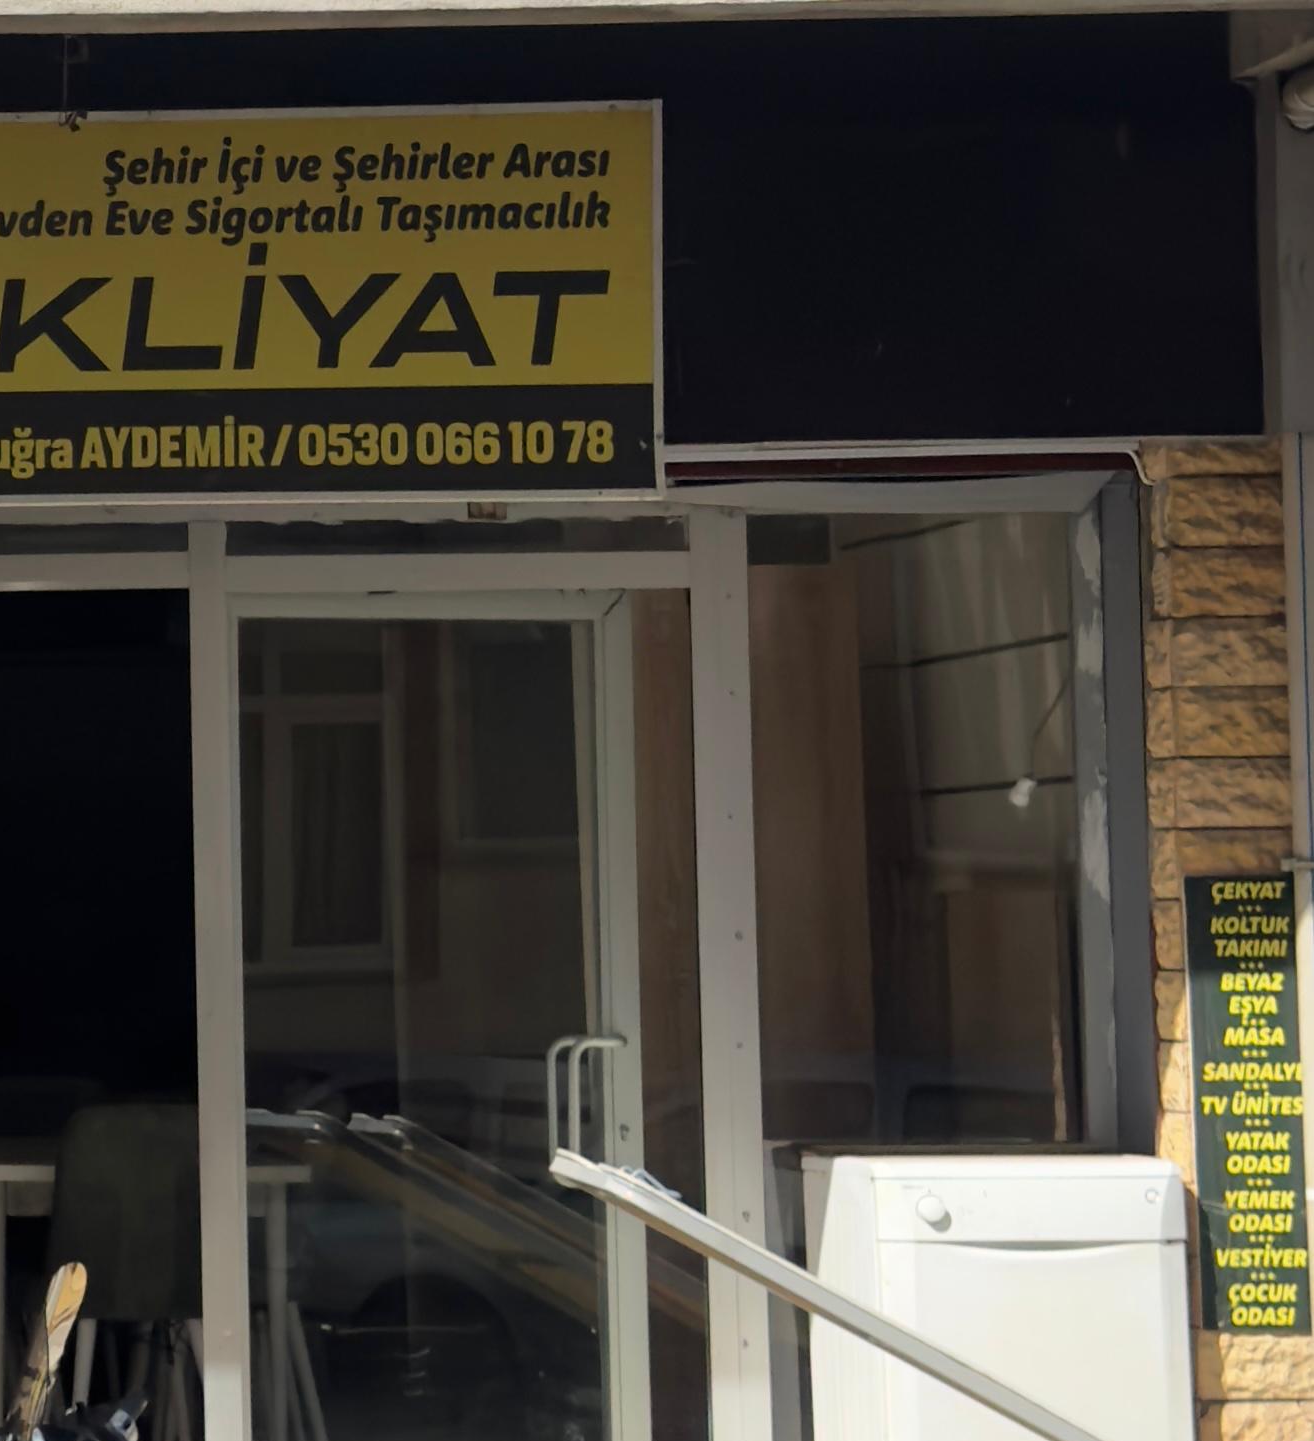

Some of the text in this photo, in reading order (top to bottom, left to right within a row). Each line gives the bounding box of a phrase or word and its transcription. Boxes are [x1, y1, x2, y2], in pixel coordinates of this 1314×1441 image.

[104, 137, 609, 196] Şehir İçi ve Şehirler Arası
[105, 201, 172, 235] Eve
[186, 195, 362, 246] Sigortalı
[378, 192, 609, 241] Taşımacılık
[80, 415, 265, 470] AYDEMİR
[298, 422, 408, 467] 0530
[416, 421, 500, 466] 066
[509, 421, 553, 465] 10
[561, 419, 614, 464] 78
[1211, 882, 1285, 905] ÇEKYAT
[1210, 916, 1290, 934] KOLTUK
[1214, 939, 1287, 958] TAKIMI
[1220, 973, 1285, 992] BEYAZ
[1229, 996, 1278, 1019] EŞYA
[1223, 1027, 1285, 1046] MASA
[1201, 1091, 1303, 1115] TV ÜNİTES
[1225, 1132, 1290, 1151] YATAK
[1226, 1155, 1291, 1174] ODASI
[1225, 1190, 1295, 1210] YEMEK
[1228, 1214, 1293, 1232] ODASI
[1215, 1242, 1308, 1268] VESTİYER
[1227, 1284, 1297, 1308] ÇOCUK
[1231, 1307, 1296, 1326] ODASI
